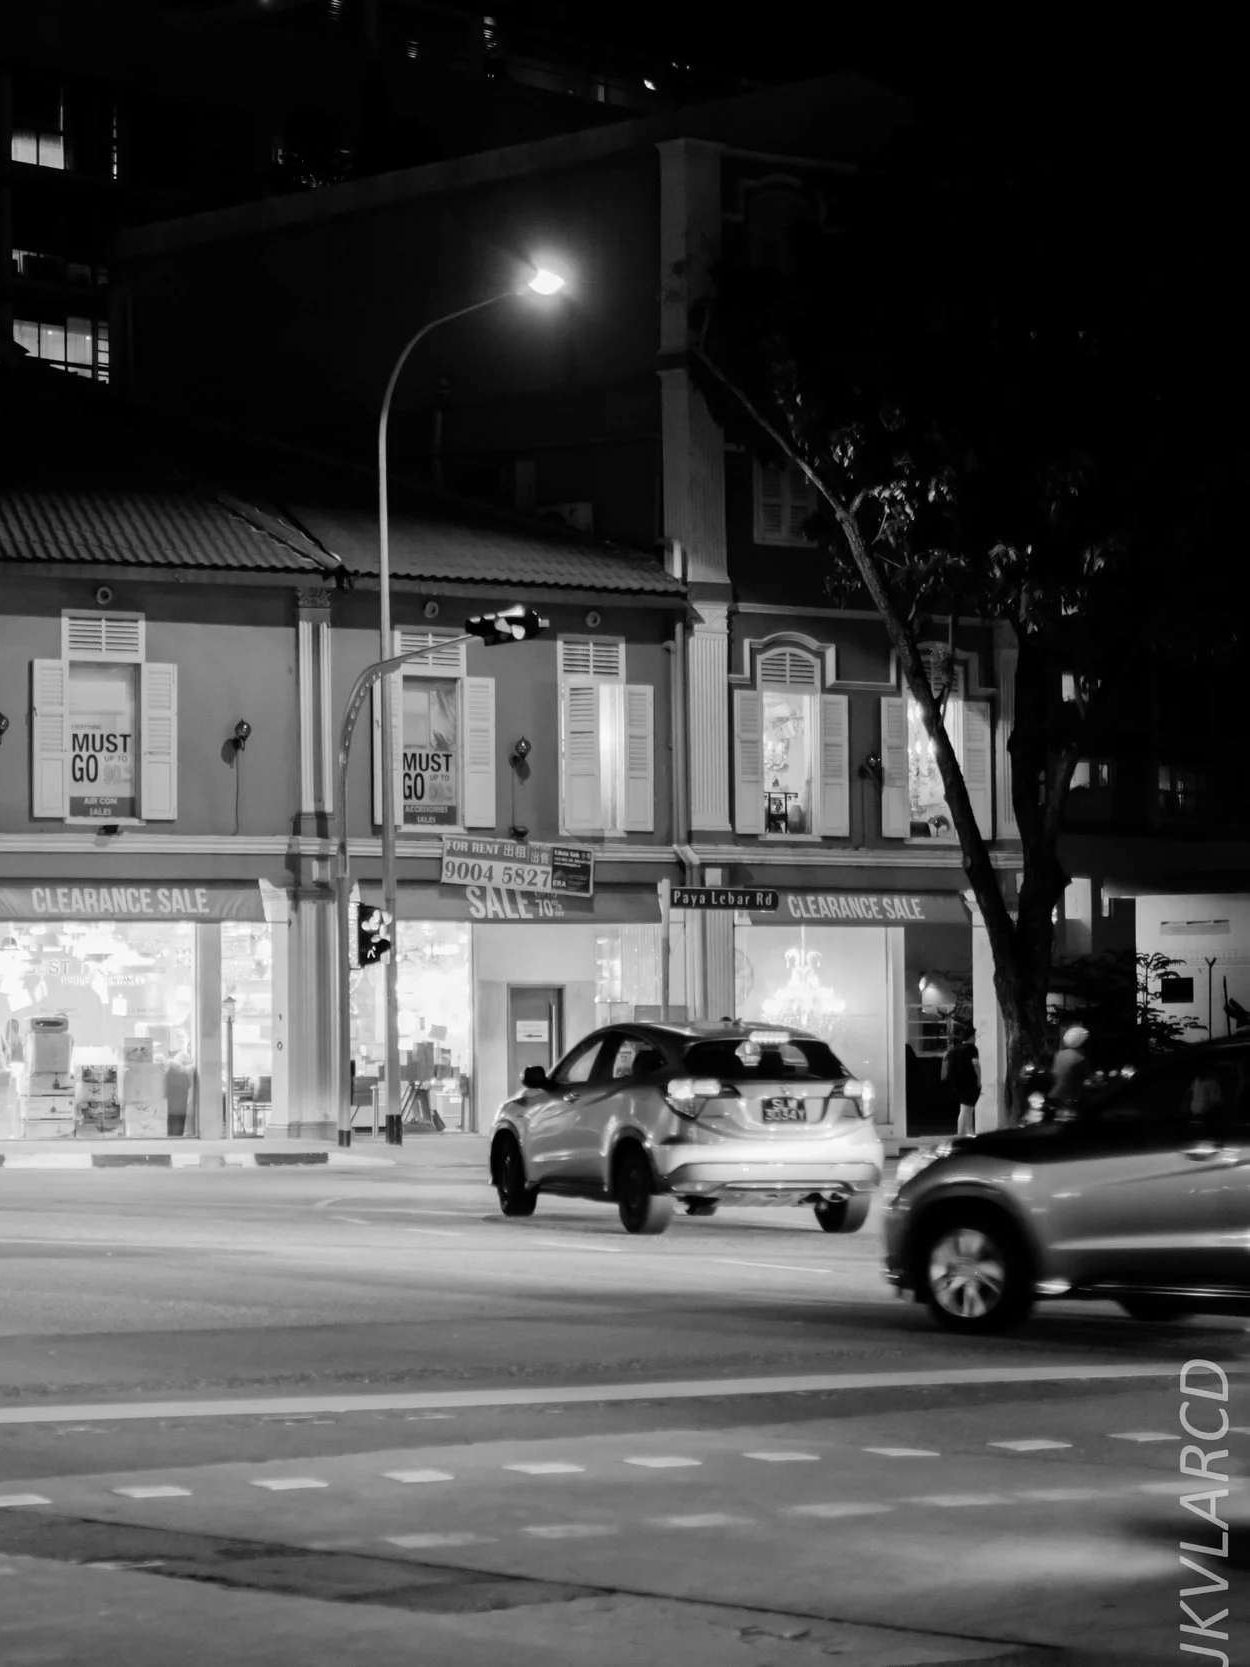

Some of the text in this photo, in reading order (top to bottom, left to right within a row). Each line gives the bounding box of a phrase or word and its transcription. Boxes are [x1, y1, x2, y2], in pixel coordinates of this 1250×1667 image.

[72, 733, 131, 753] MUST
[72, 754, 98, 783] GO
[403, 753, 453, 772] MUST
[403, 773, 424, 801] GO
[83, 797, 117, 805] AIR CON
[445, 840, 499, 855] FOR RENT
[444, 860, 494, 882] 9004
[501, 867, 551, 888] 5827
[552, 880, 567, 888] ERA
[31, 888, 210, 913] CLEARANCE SALE
[465, 886, 534, 919] SALE
[673, 891, 772, 907] Paya Lebar Rd
[788, 896, 926, 920] CLEARANCE SALE
